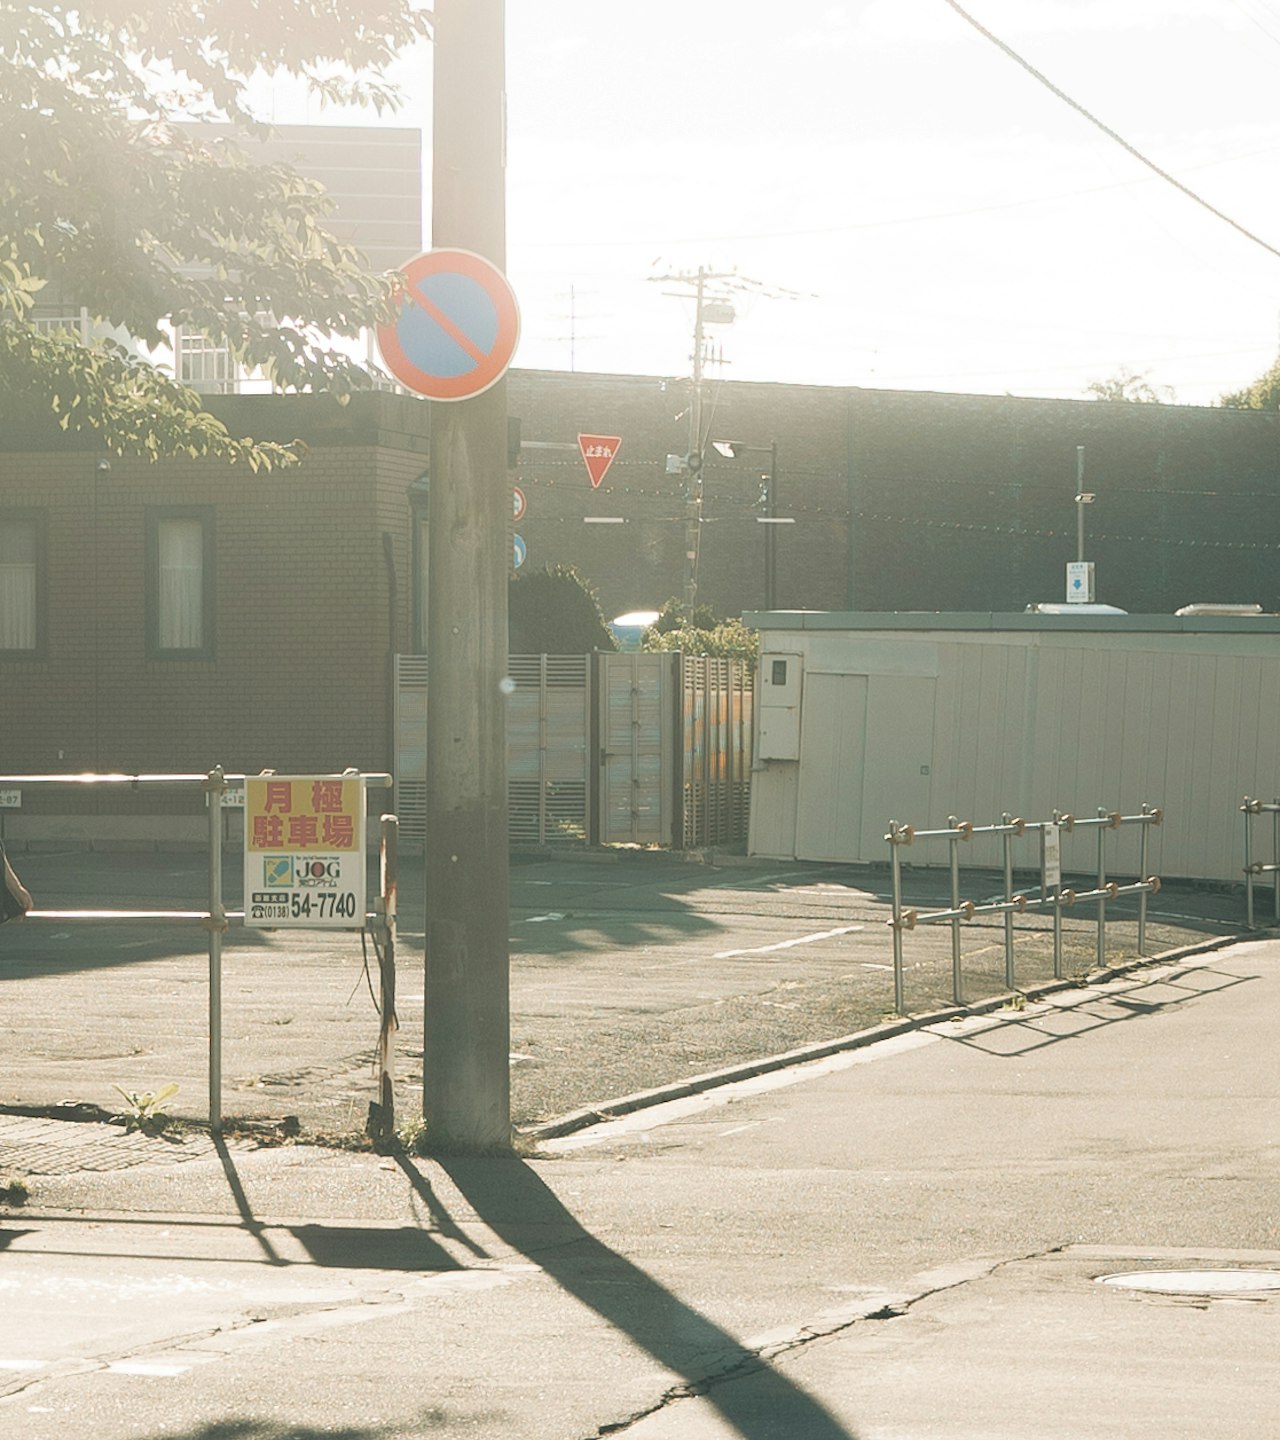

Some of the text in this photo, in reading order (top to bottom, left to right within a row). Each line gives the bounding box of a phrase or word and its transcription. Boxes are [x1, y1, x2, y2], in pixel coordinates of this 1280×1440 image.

[585, 444, 613, 458] 止まれ
[264, 780, 344, 813] 月極
[252, 814, 354, 848] 駐車場
[296, 861, 340, 878] JOG
[264, 892, 356, 919] (0138) 54-7740
